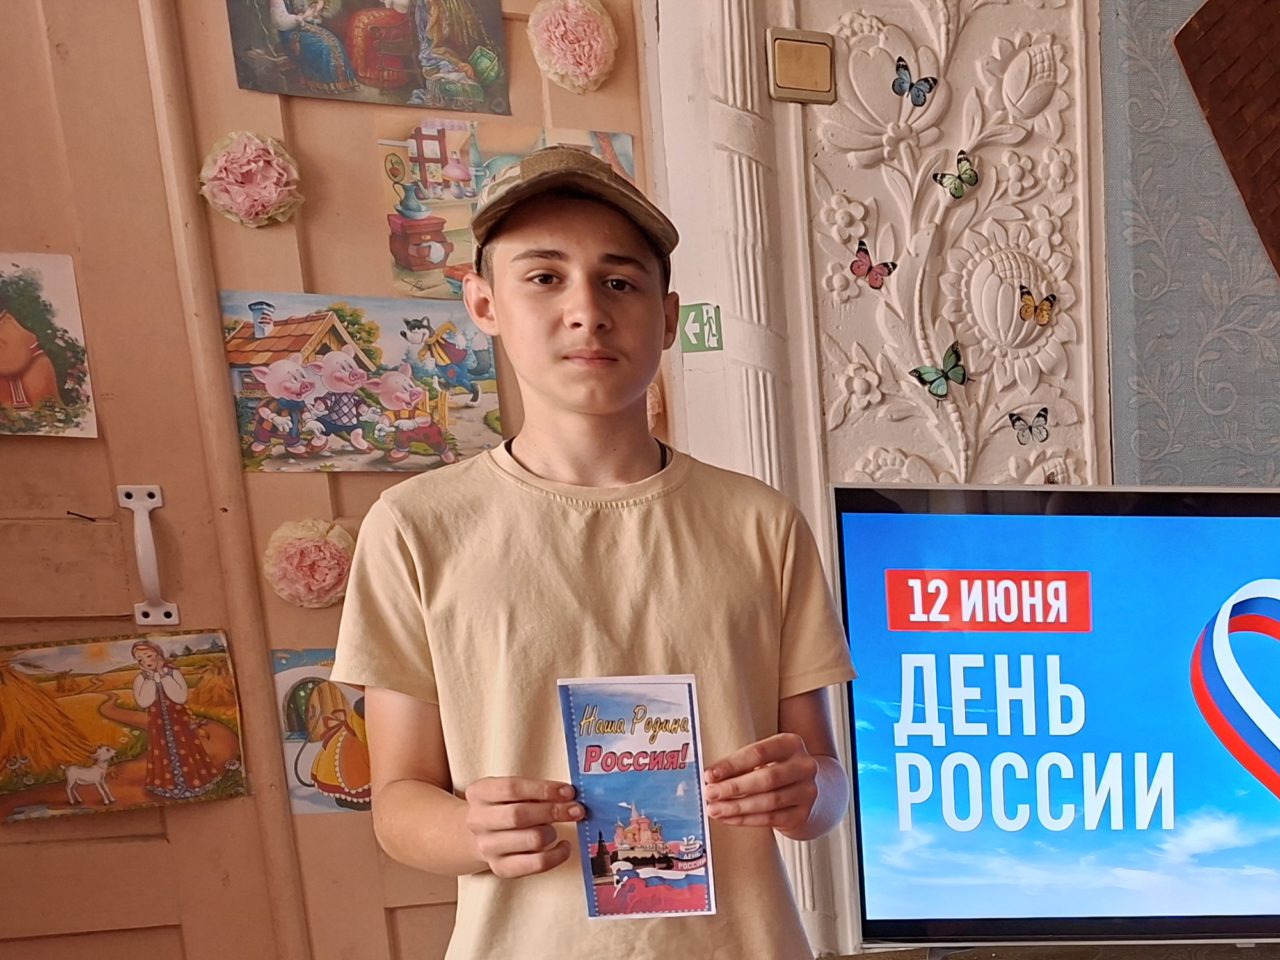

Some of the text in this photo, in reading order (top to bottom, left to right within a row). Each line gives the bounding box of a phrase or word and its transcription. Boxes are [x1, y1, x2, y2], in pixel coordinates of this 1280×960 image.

[908, 578, 1068, 623] 12 ИЮНЯ
[893, 653, 1086, 747] ДЕНЬ
[579, 704, 690, 744] Наша Родина
[583, 742, 690, 772] Россия!
[896, 751, 1176, 832] РОССИИ
